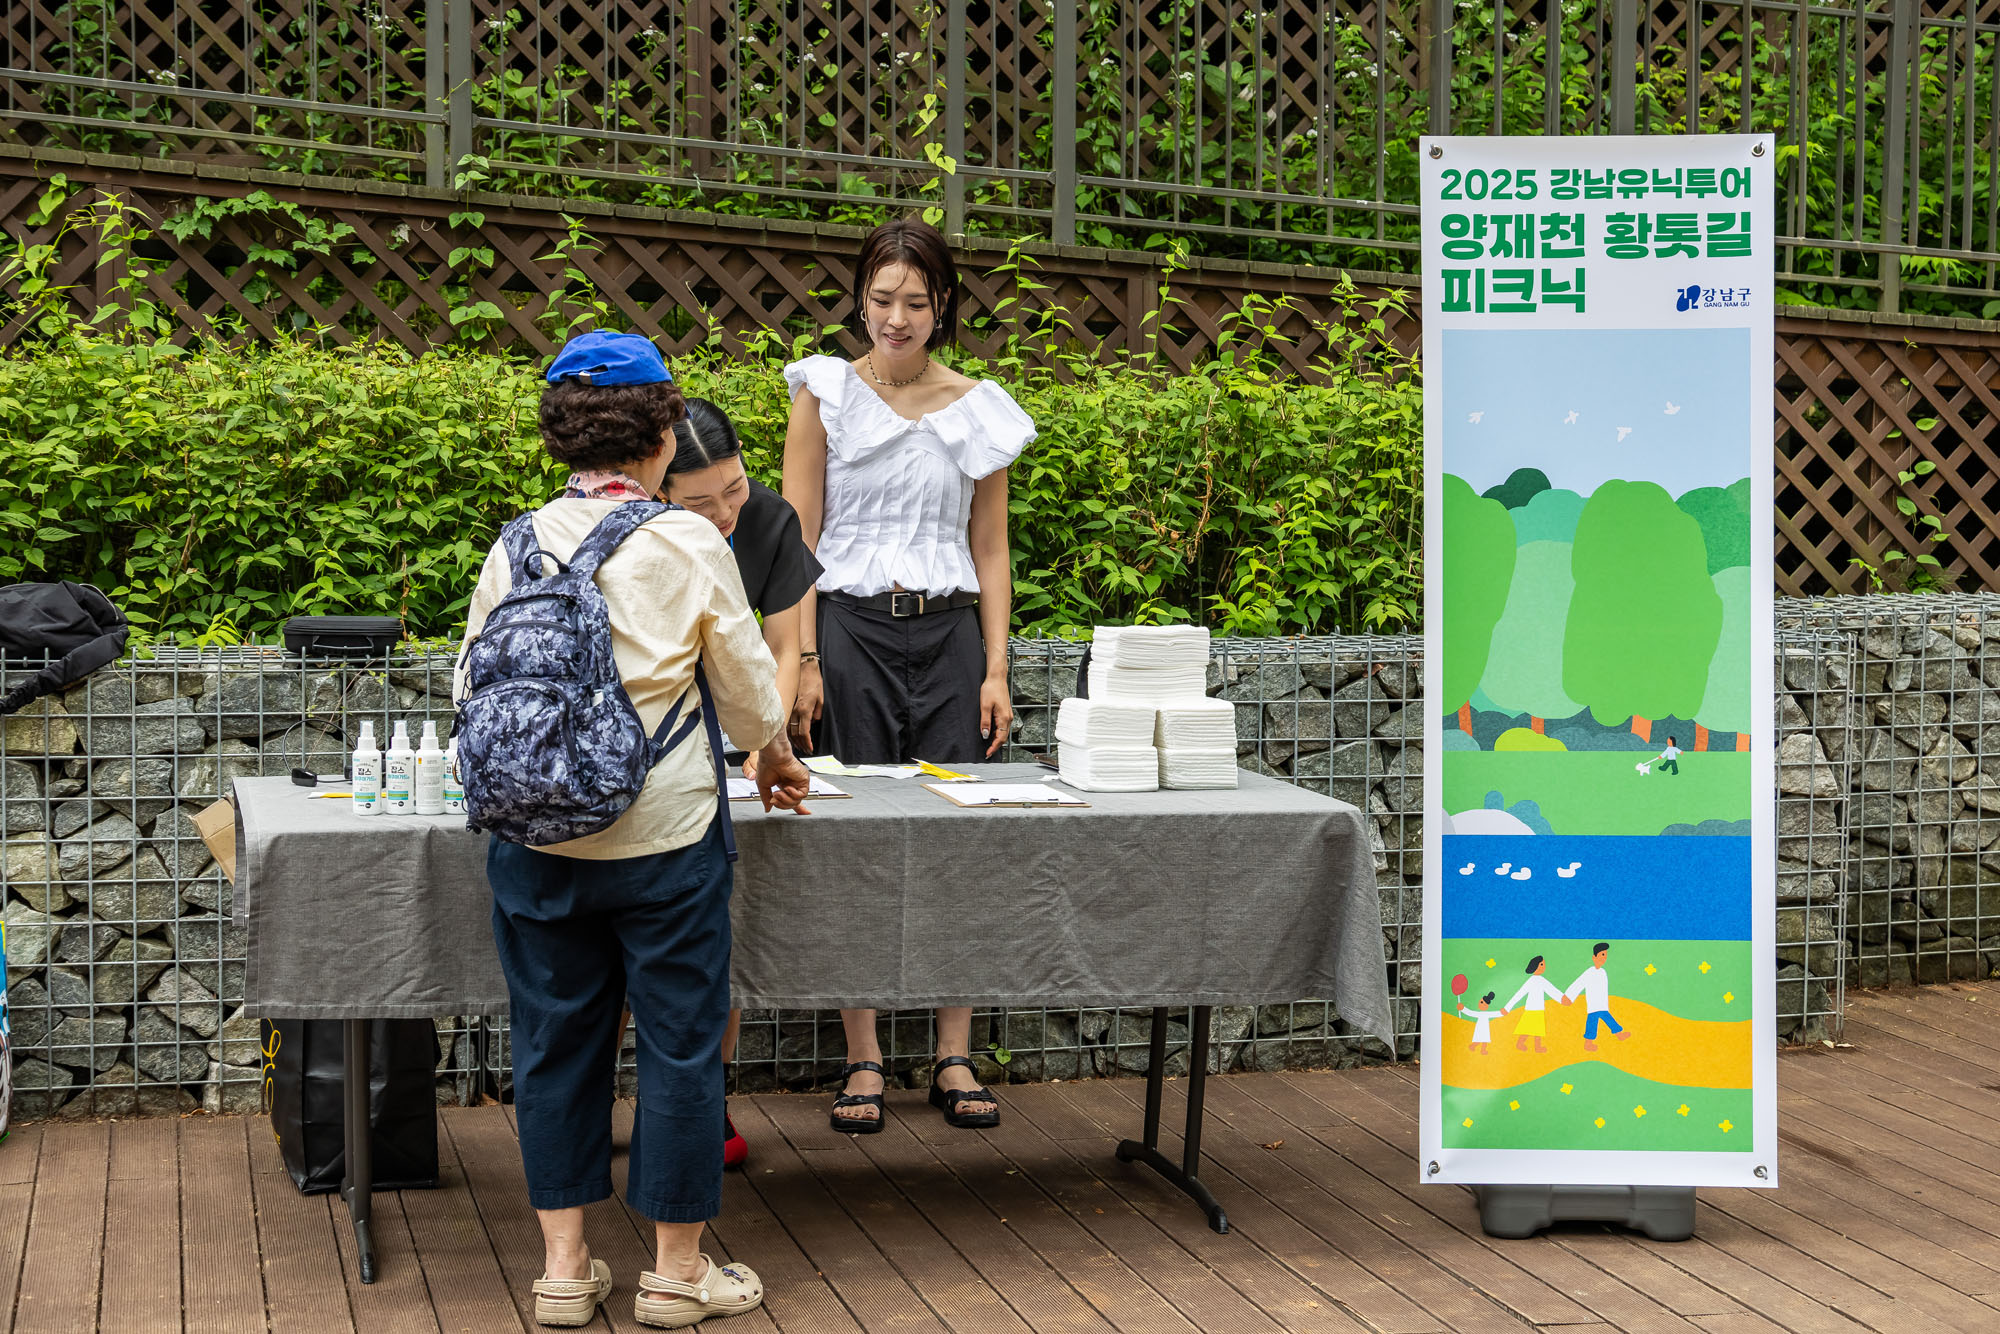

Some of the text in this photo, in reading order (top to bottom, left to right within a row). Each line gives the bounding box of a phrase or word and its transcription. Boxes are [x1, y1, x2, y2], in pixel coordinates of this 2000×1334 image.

[1440, 166, 1752, 201] 2025 강남유닉투어
[1440, 211, 1753, 260] 양재천 황톳길
[1440, 267, 1586, 314] 피크닉
[1702, 287, 1752, 302] 강남구
